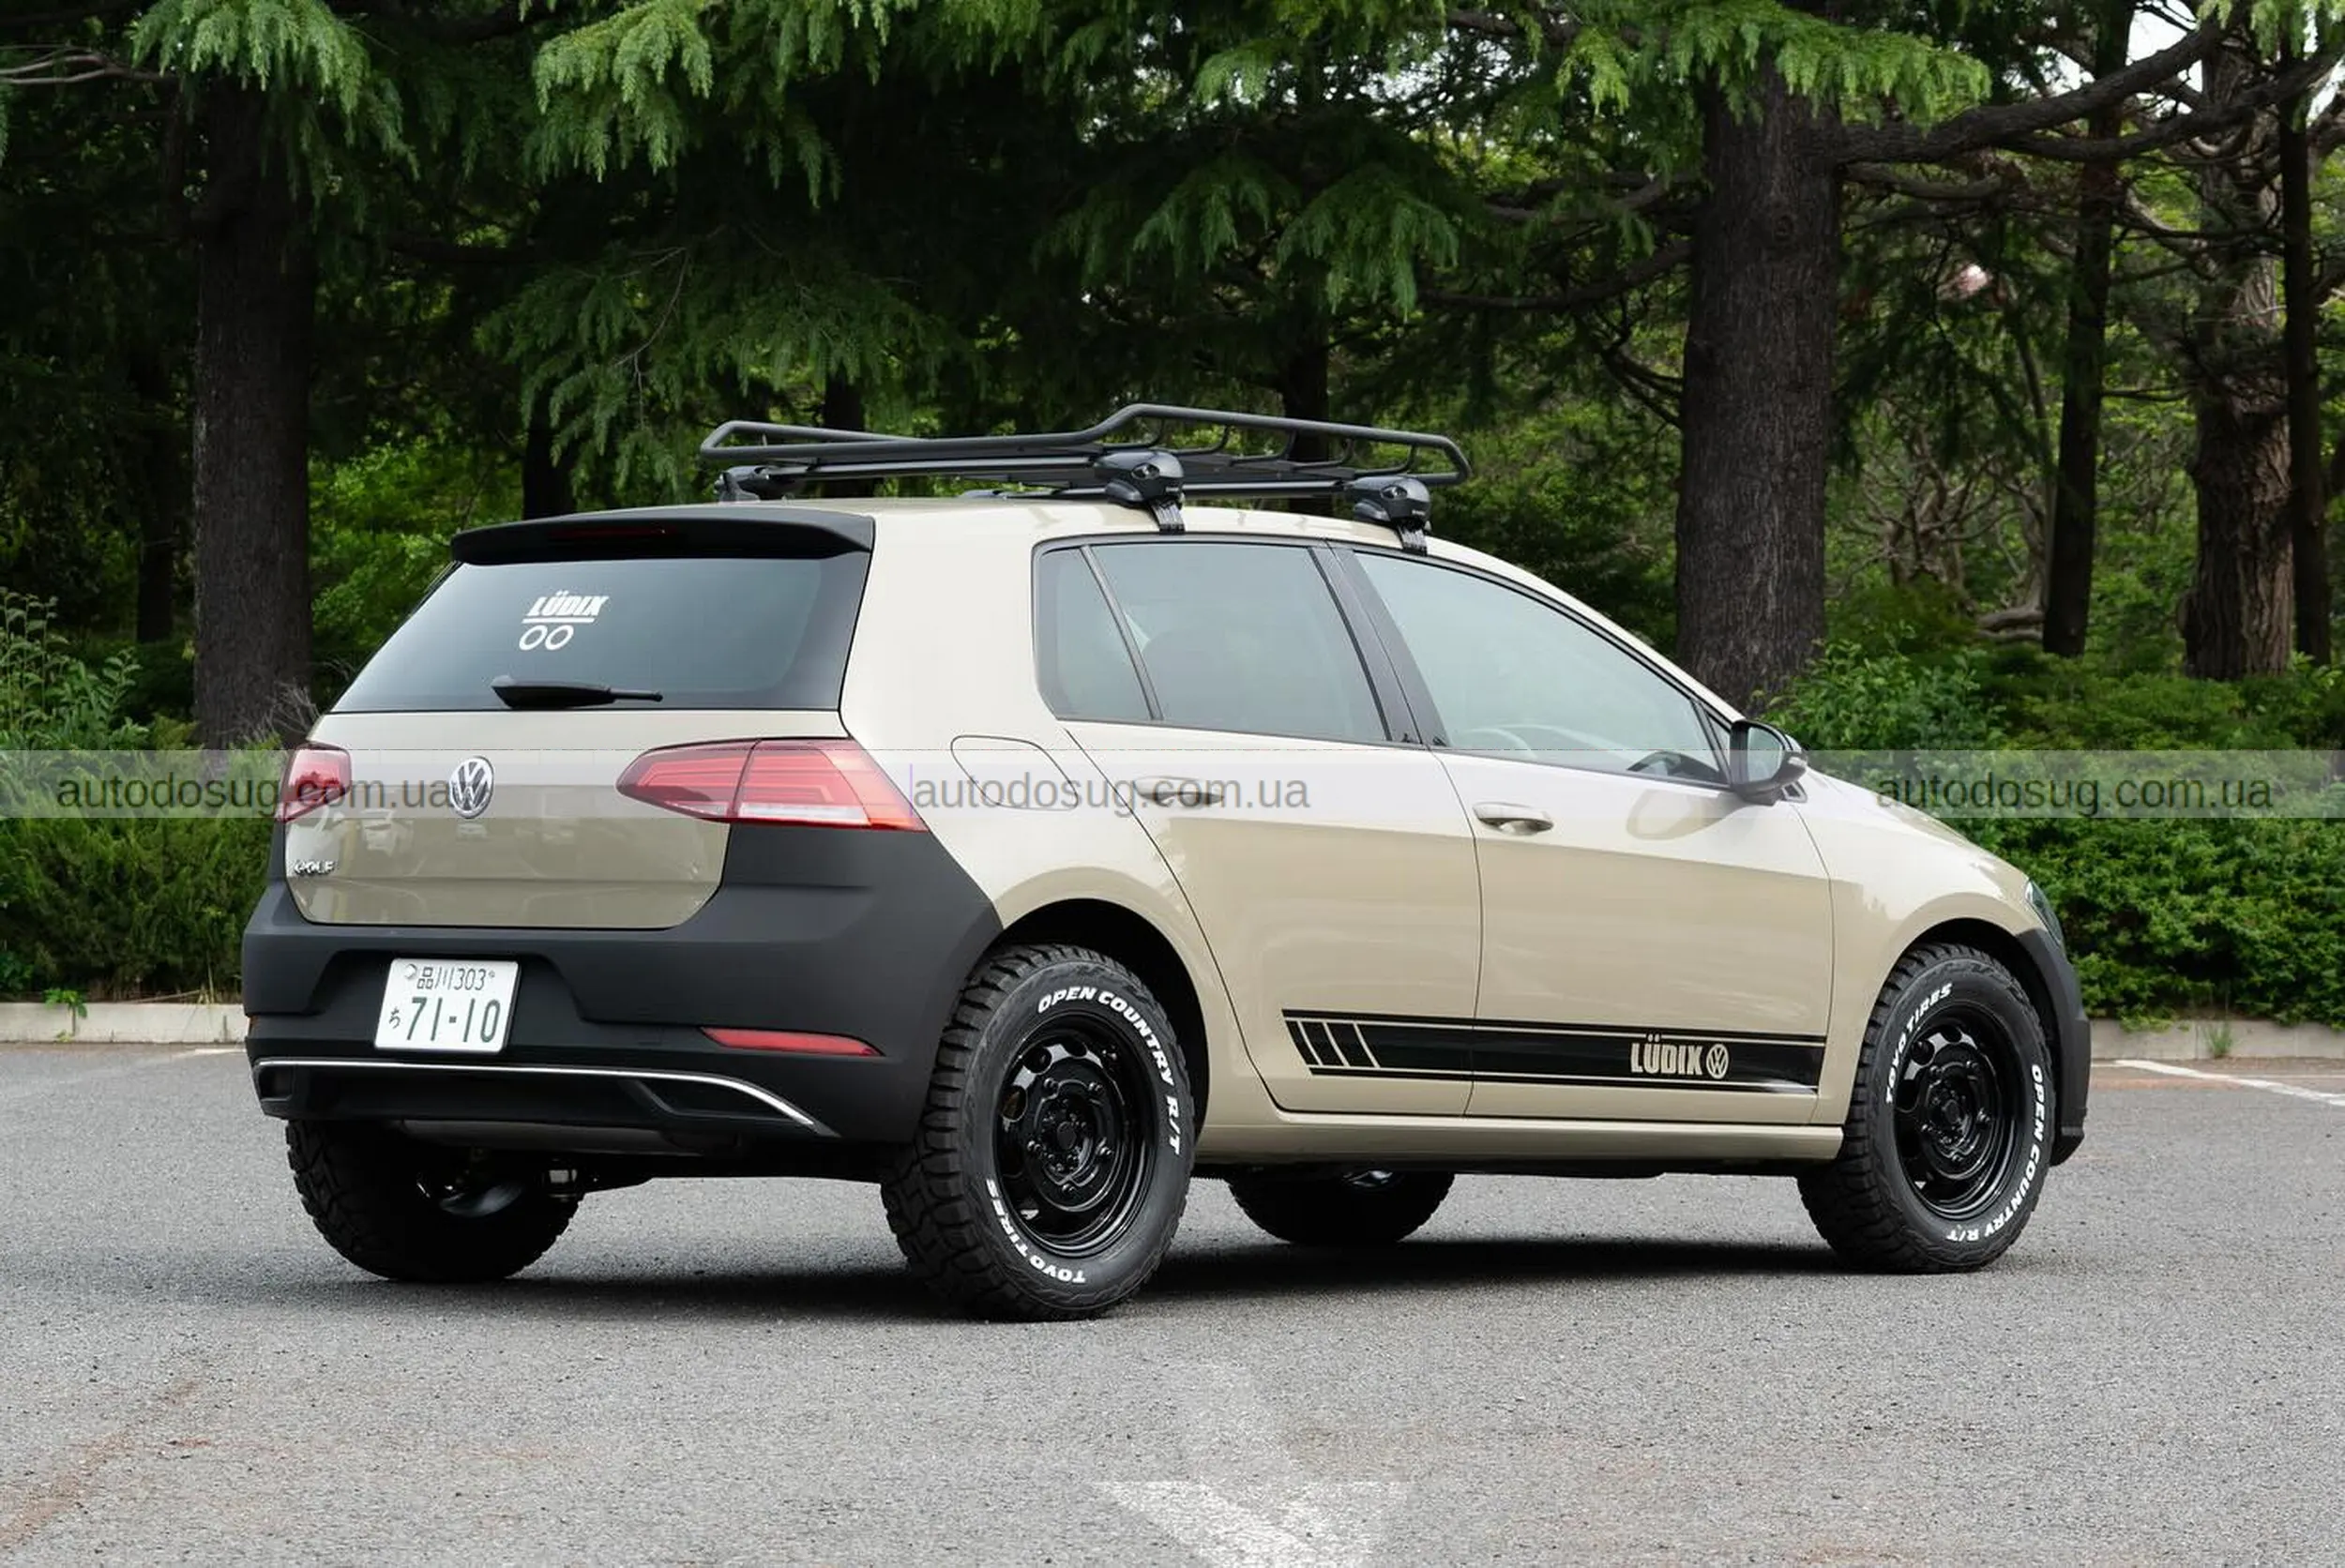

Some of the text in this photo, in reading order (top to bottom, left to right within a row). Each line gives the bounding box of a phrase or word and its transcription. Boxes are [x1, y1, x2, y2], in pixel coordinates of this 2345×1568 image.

[526, 590, 610, 616] LÜDIX
[453, 968, 487, 990] 303
[1037, 986, 1182, 1155] OPEN COUNTRY R/T
[1630, 1033, 1703, 1076] LÜDIX
[1885, 982, 1953, 1104] TOYO TIRES
[1945, 1064, 2046, 1243] OPEN COUNTRY R/T
[986, 1178, 1086, 1284] TOYO TIRES
